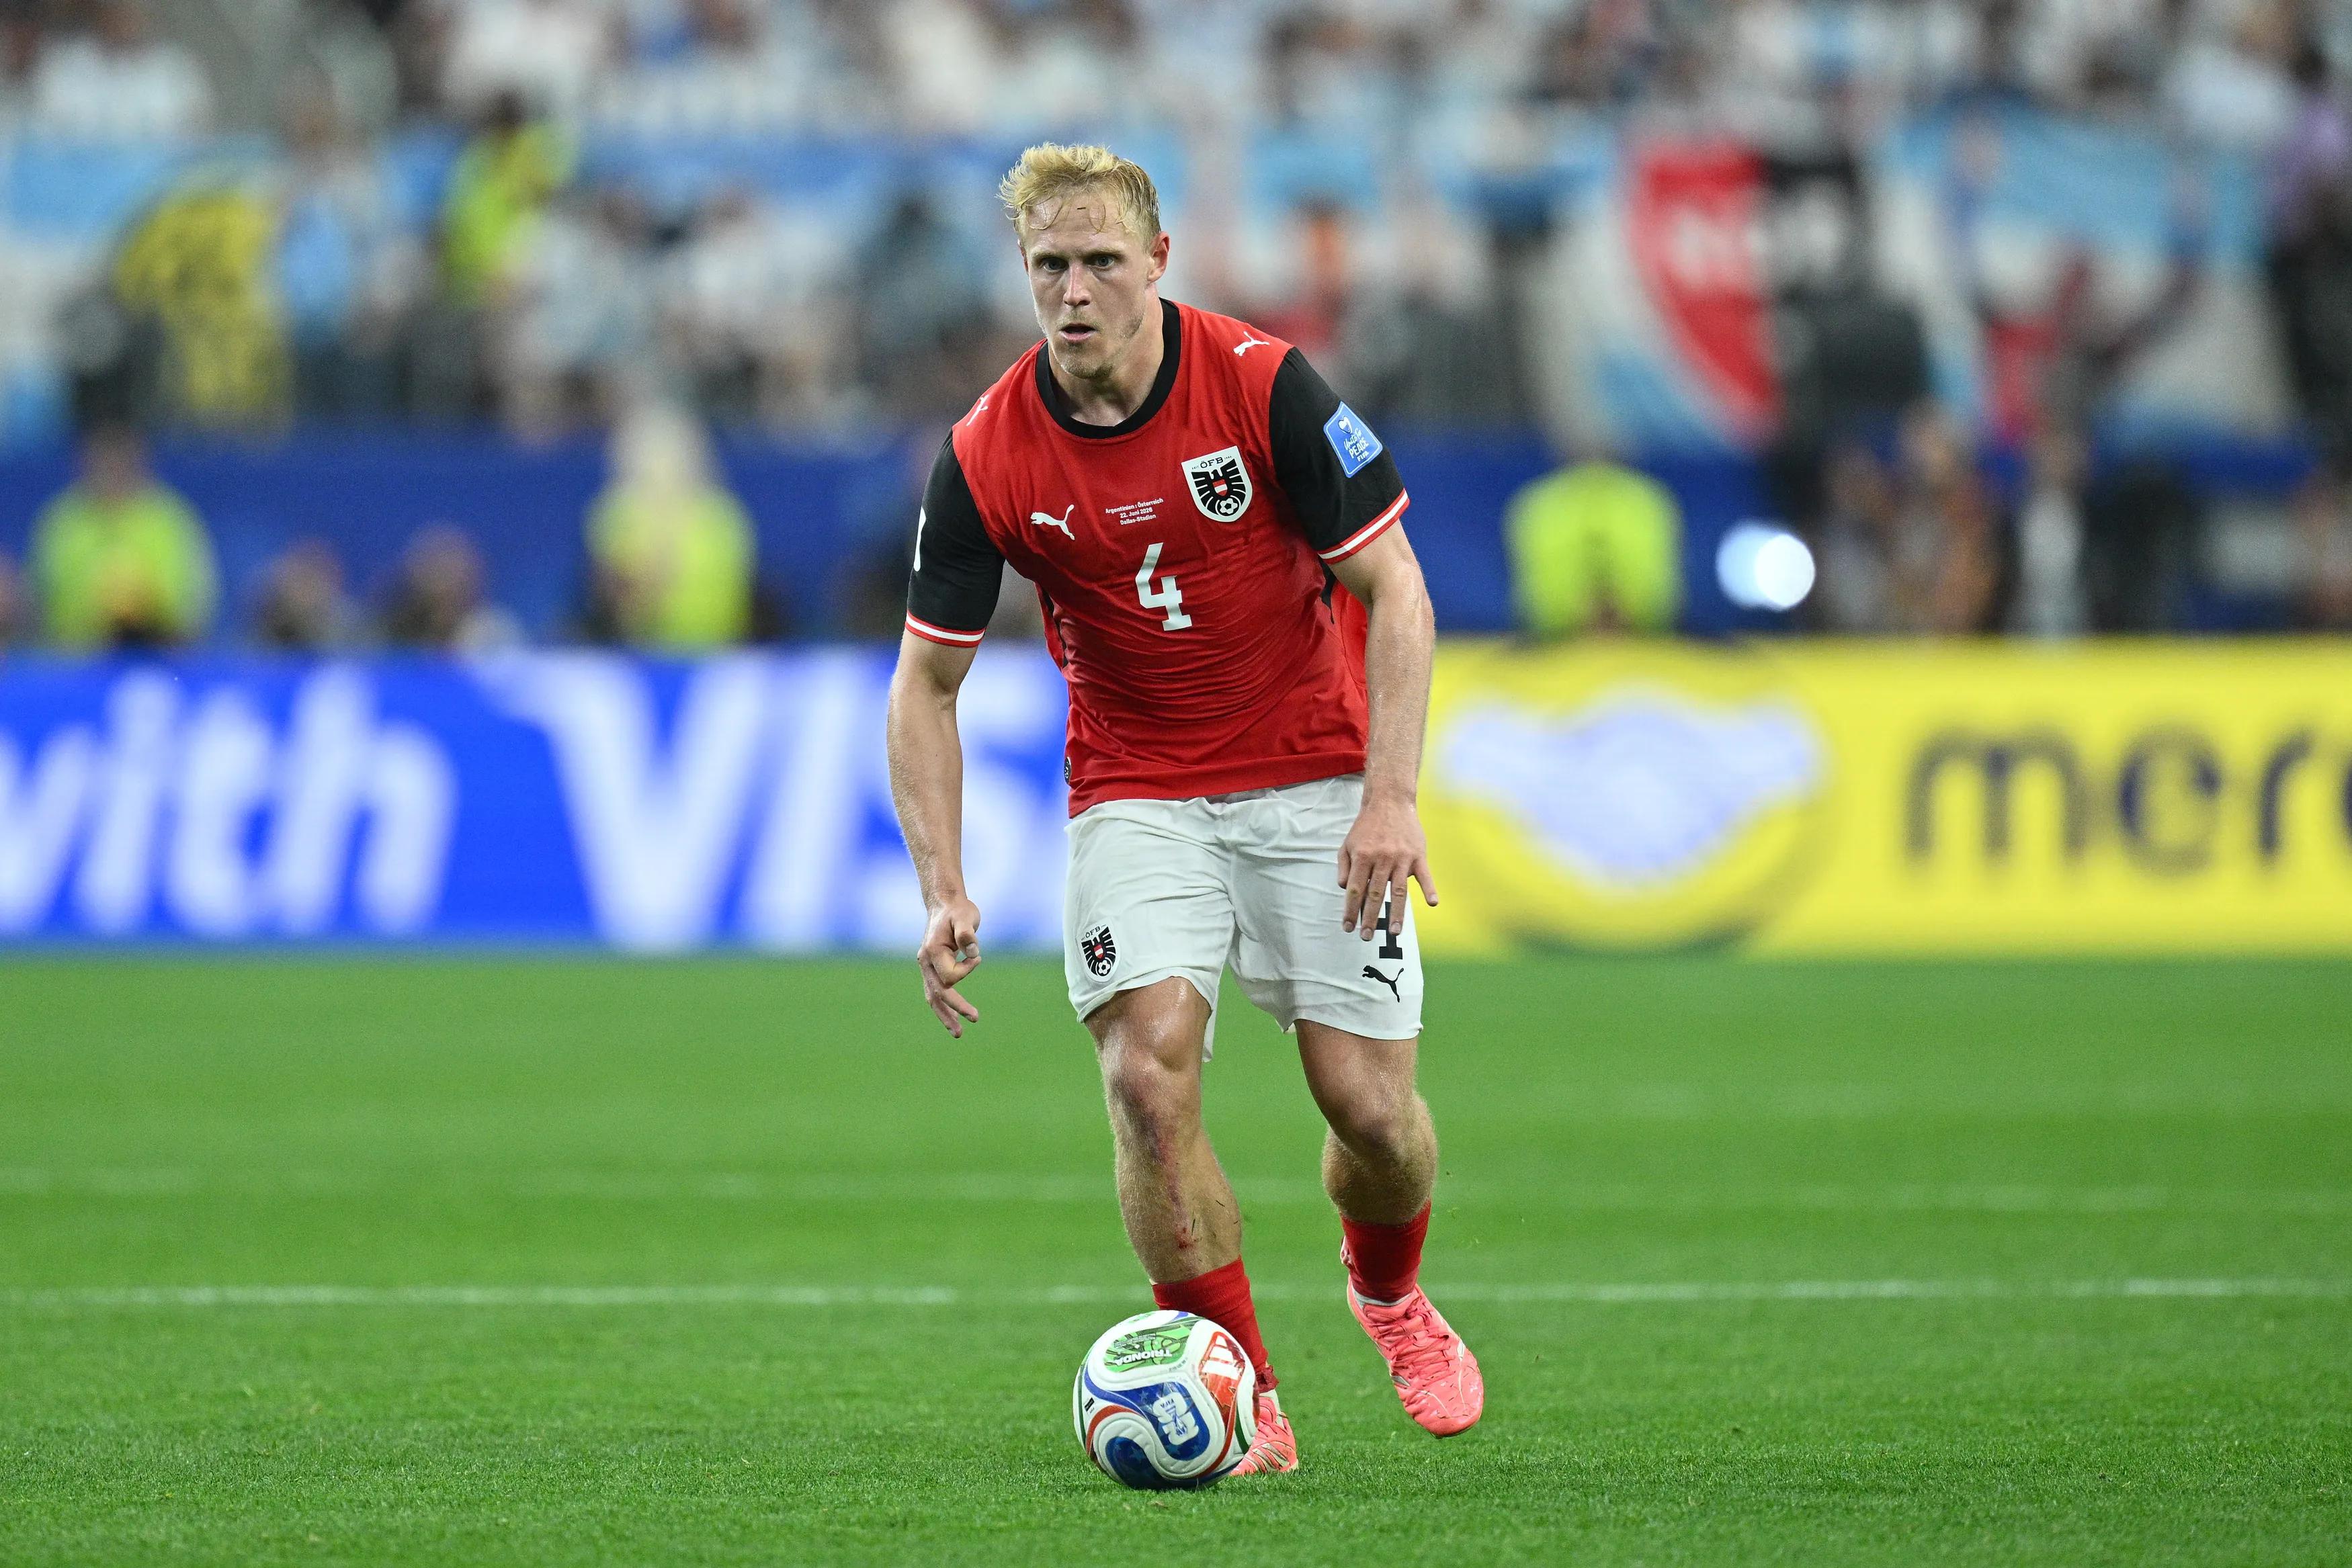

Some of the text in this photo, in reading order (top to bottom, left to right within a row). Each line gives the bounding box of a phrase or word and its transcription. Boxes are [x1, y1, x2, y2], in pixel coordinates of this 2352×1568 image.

[1349, 437, 1369, 459] PEACE
[1357, 451, 1369, 462] FIFA
[1200, 457, 1223, 468] ÖFB
[1105, 505, 1134, 514] Argentinien
[1137, 498, 1163, 508] Österreich
[1140, 507, 1153, 515] 2026
[1120, 514, 1156, 525] Dallas-Stadion
[1135, 542, 1192, 631] 4
[464, 652, 1067, 951] VIS
[1900, 719, 2352, 875] mer
[1115, 1348, 1173, 1366] TRIONDA
